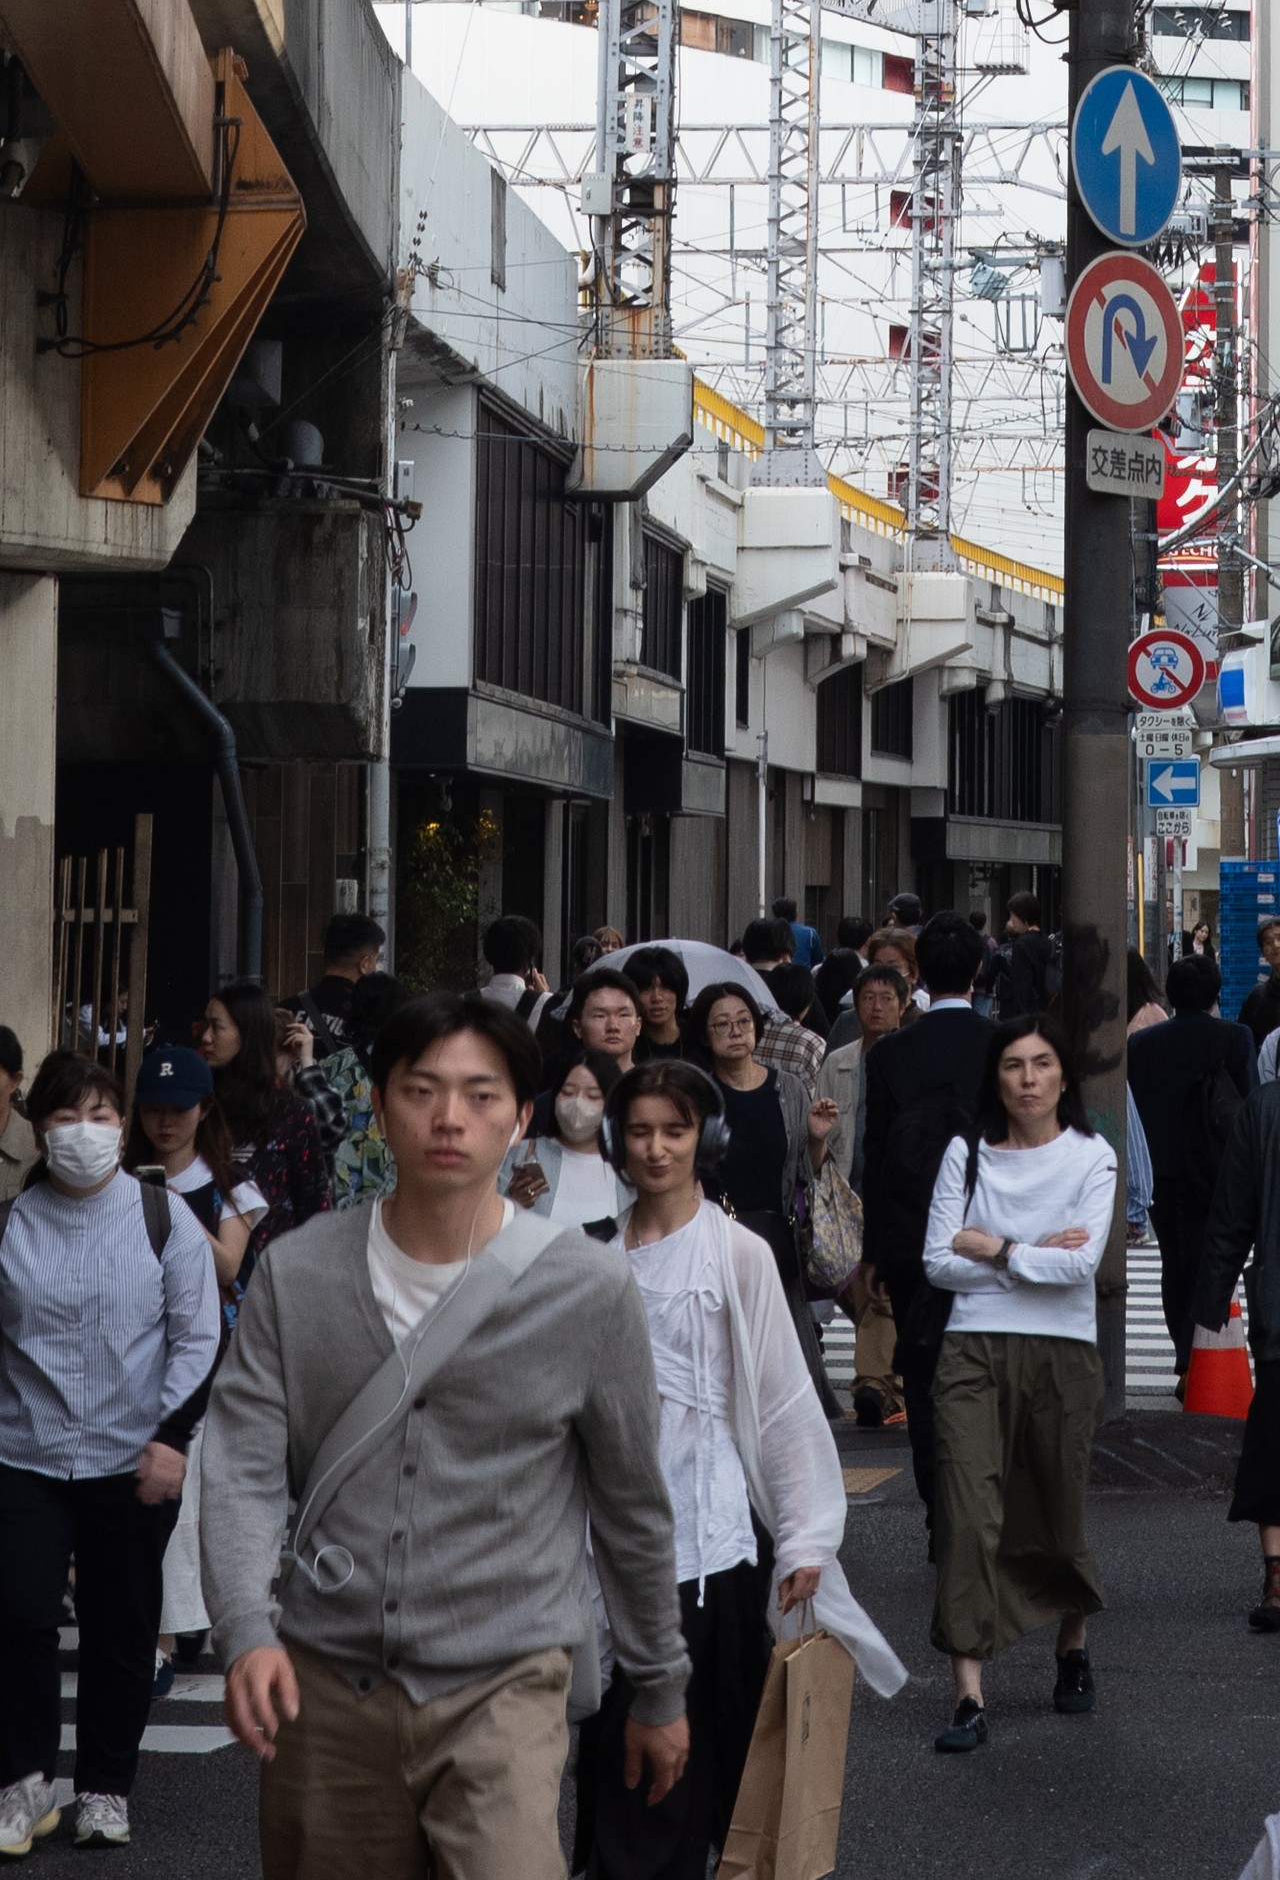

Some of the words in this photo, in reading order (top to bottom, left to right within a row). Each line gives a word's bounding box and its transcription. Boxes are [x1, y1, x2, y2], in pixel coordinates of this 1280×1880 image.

[1091, 445, 1162, 485] 交差点内
[1139, 716, 1191, 727] タクシーを除く
[1158, 822, 1190, 834] ここから
[158, 1062, 174, 1077] R
